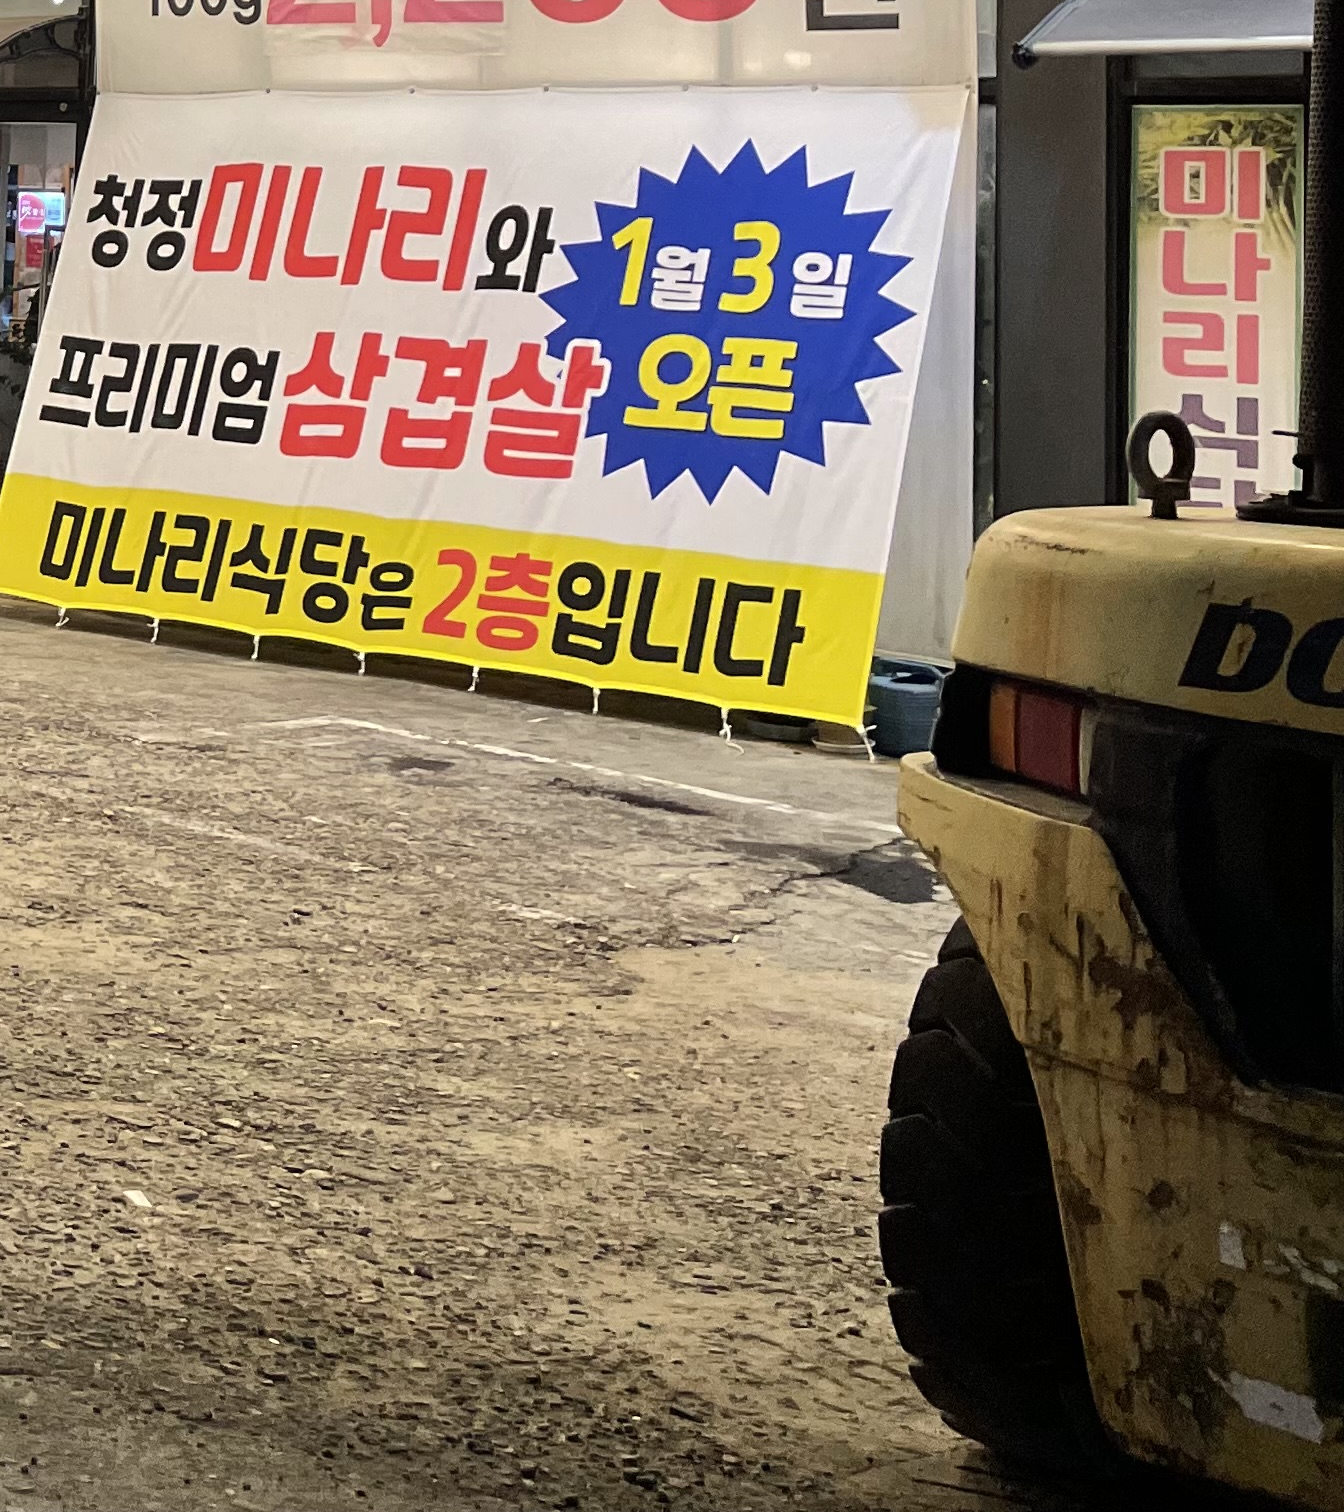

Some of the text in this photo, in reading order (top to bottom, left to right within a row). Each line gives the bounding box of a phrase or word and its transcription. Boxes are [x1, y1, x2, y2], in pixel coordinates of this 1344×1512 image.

[623, 333, 799, 441] 오픈
[39, 500, 805, 687] 미나리식당은 2층입니다
